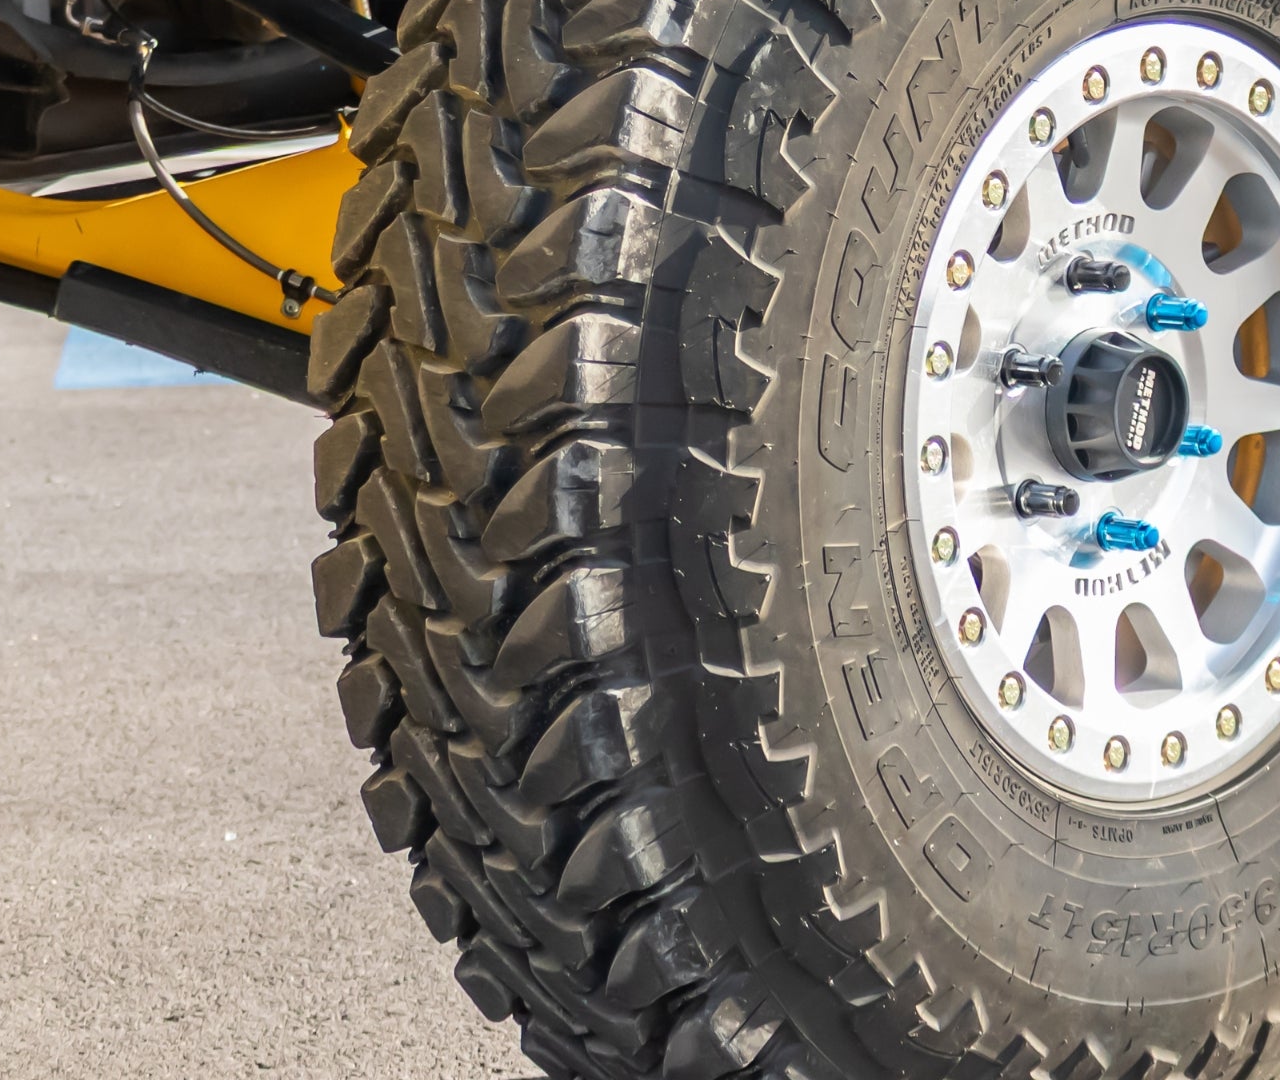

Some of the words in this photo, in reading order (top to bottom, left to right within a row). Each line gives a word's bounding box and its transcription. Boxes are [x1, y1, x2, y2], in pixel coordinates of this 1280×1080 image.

[1037, 212, 1135, 267] METHOD
[1133, 369, 1156, 450] METHOD
[823, 544, 994, 902] OPEN
